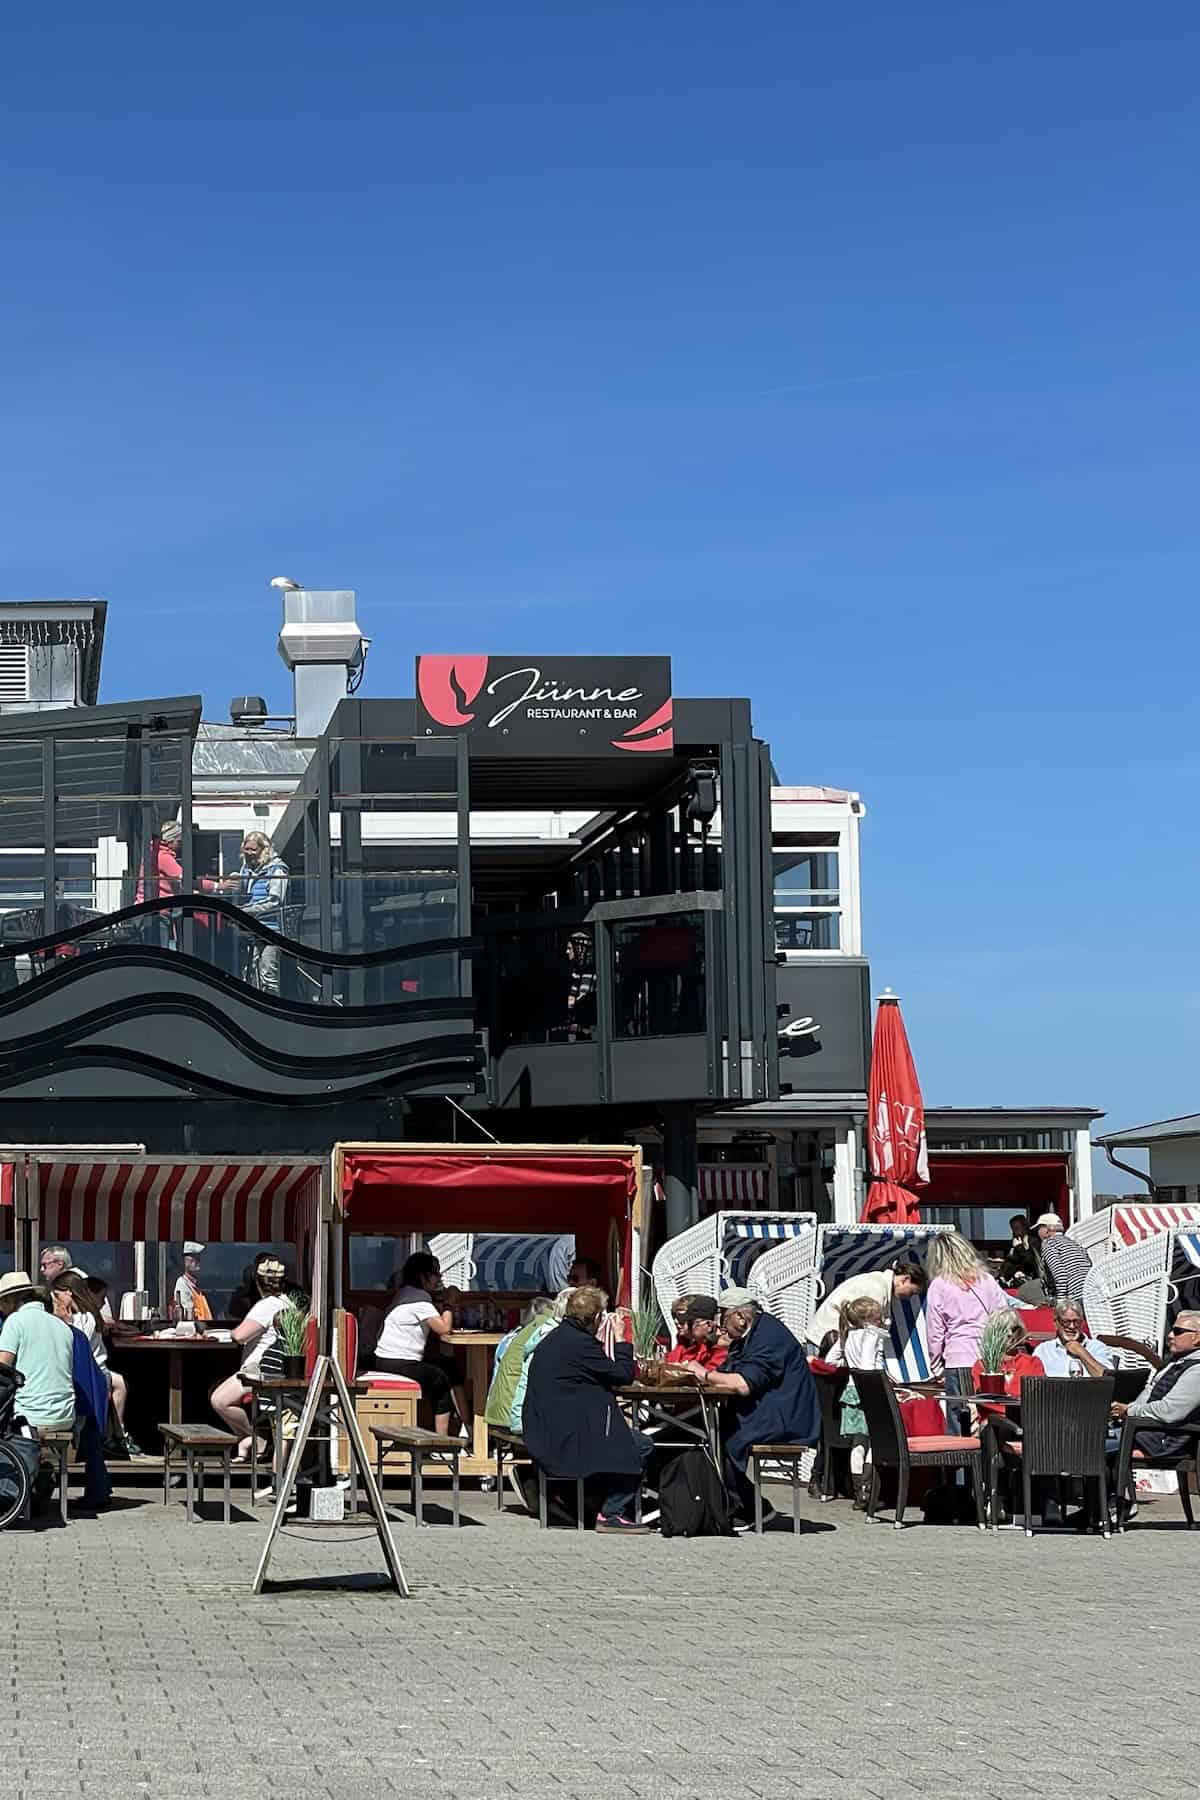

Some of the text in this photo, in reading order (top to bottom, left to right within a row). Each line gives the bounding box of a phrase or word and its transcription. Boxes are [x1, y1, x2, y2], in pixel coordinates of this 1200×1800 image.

[487, 667, 643, 729] Jünne
[526, 708, 638, 719] RESTAURANT & BAR
